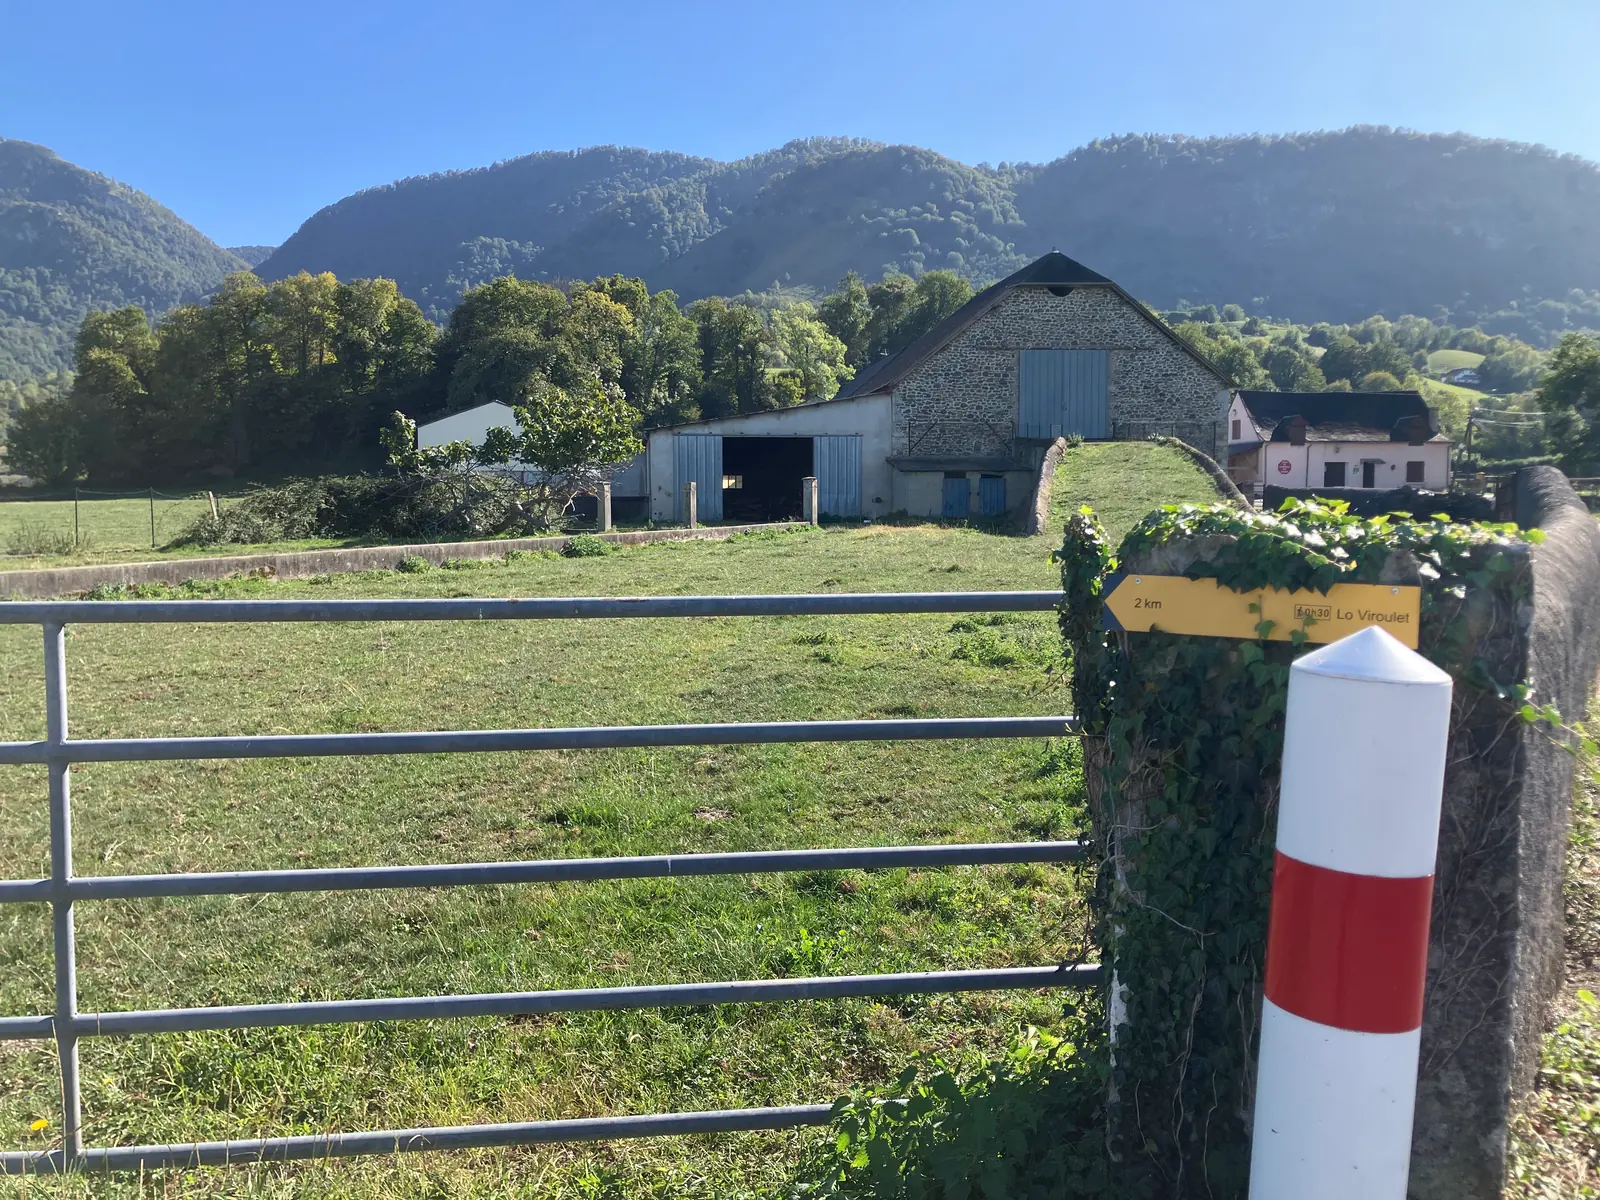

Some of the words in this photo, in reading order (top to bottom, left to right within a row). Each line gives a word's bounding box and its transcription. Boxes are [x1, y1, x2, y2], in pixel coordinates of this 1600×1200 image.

[1134, 597, 1142, 608] 2
[1144, 598, 1162, 609] km
[1304, 608, 1330, 618] 0h30
[1337, 608, 1354, 620] Lo
[1357, 609, 1410, 623] Viroulet
